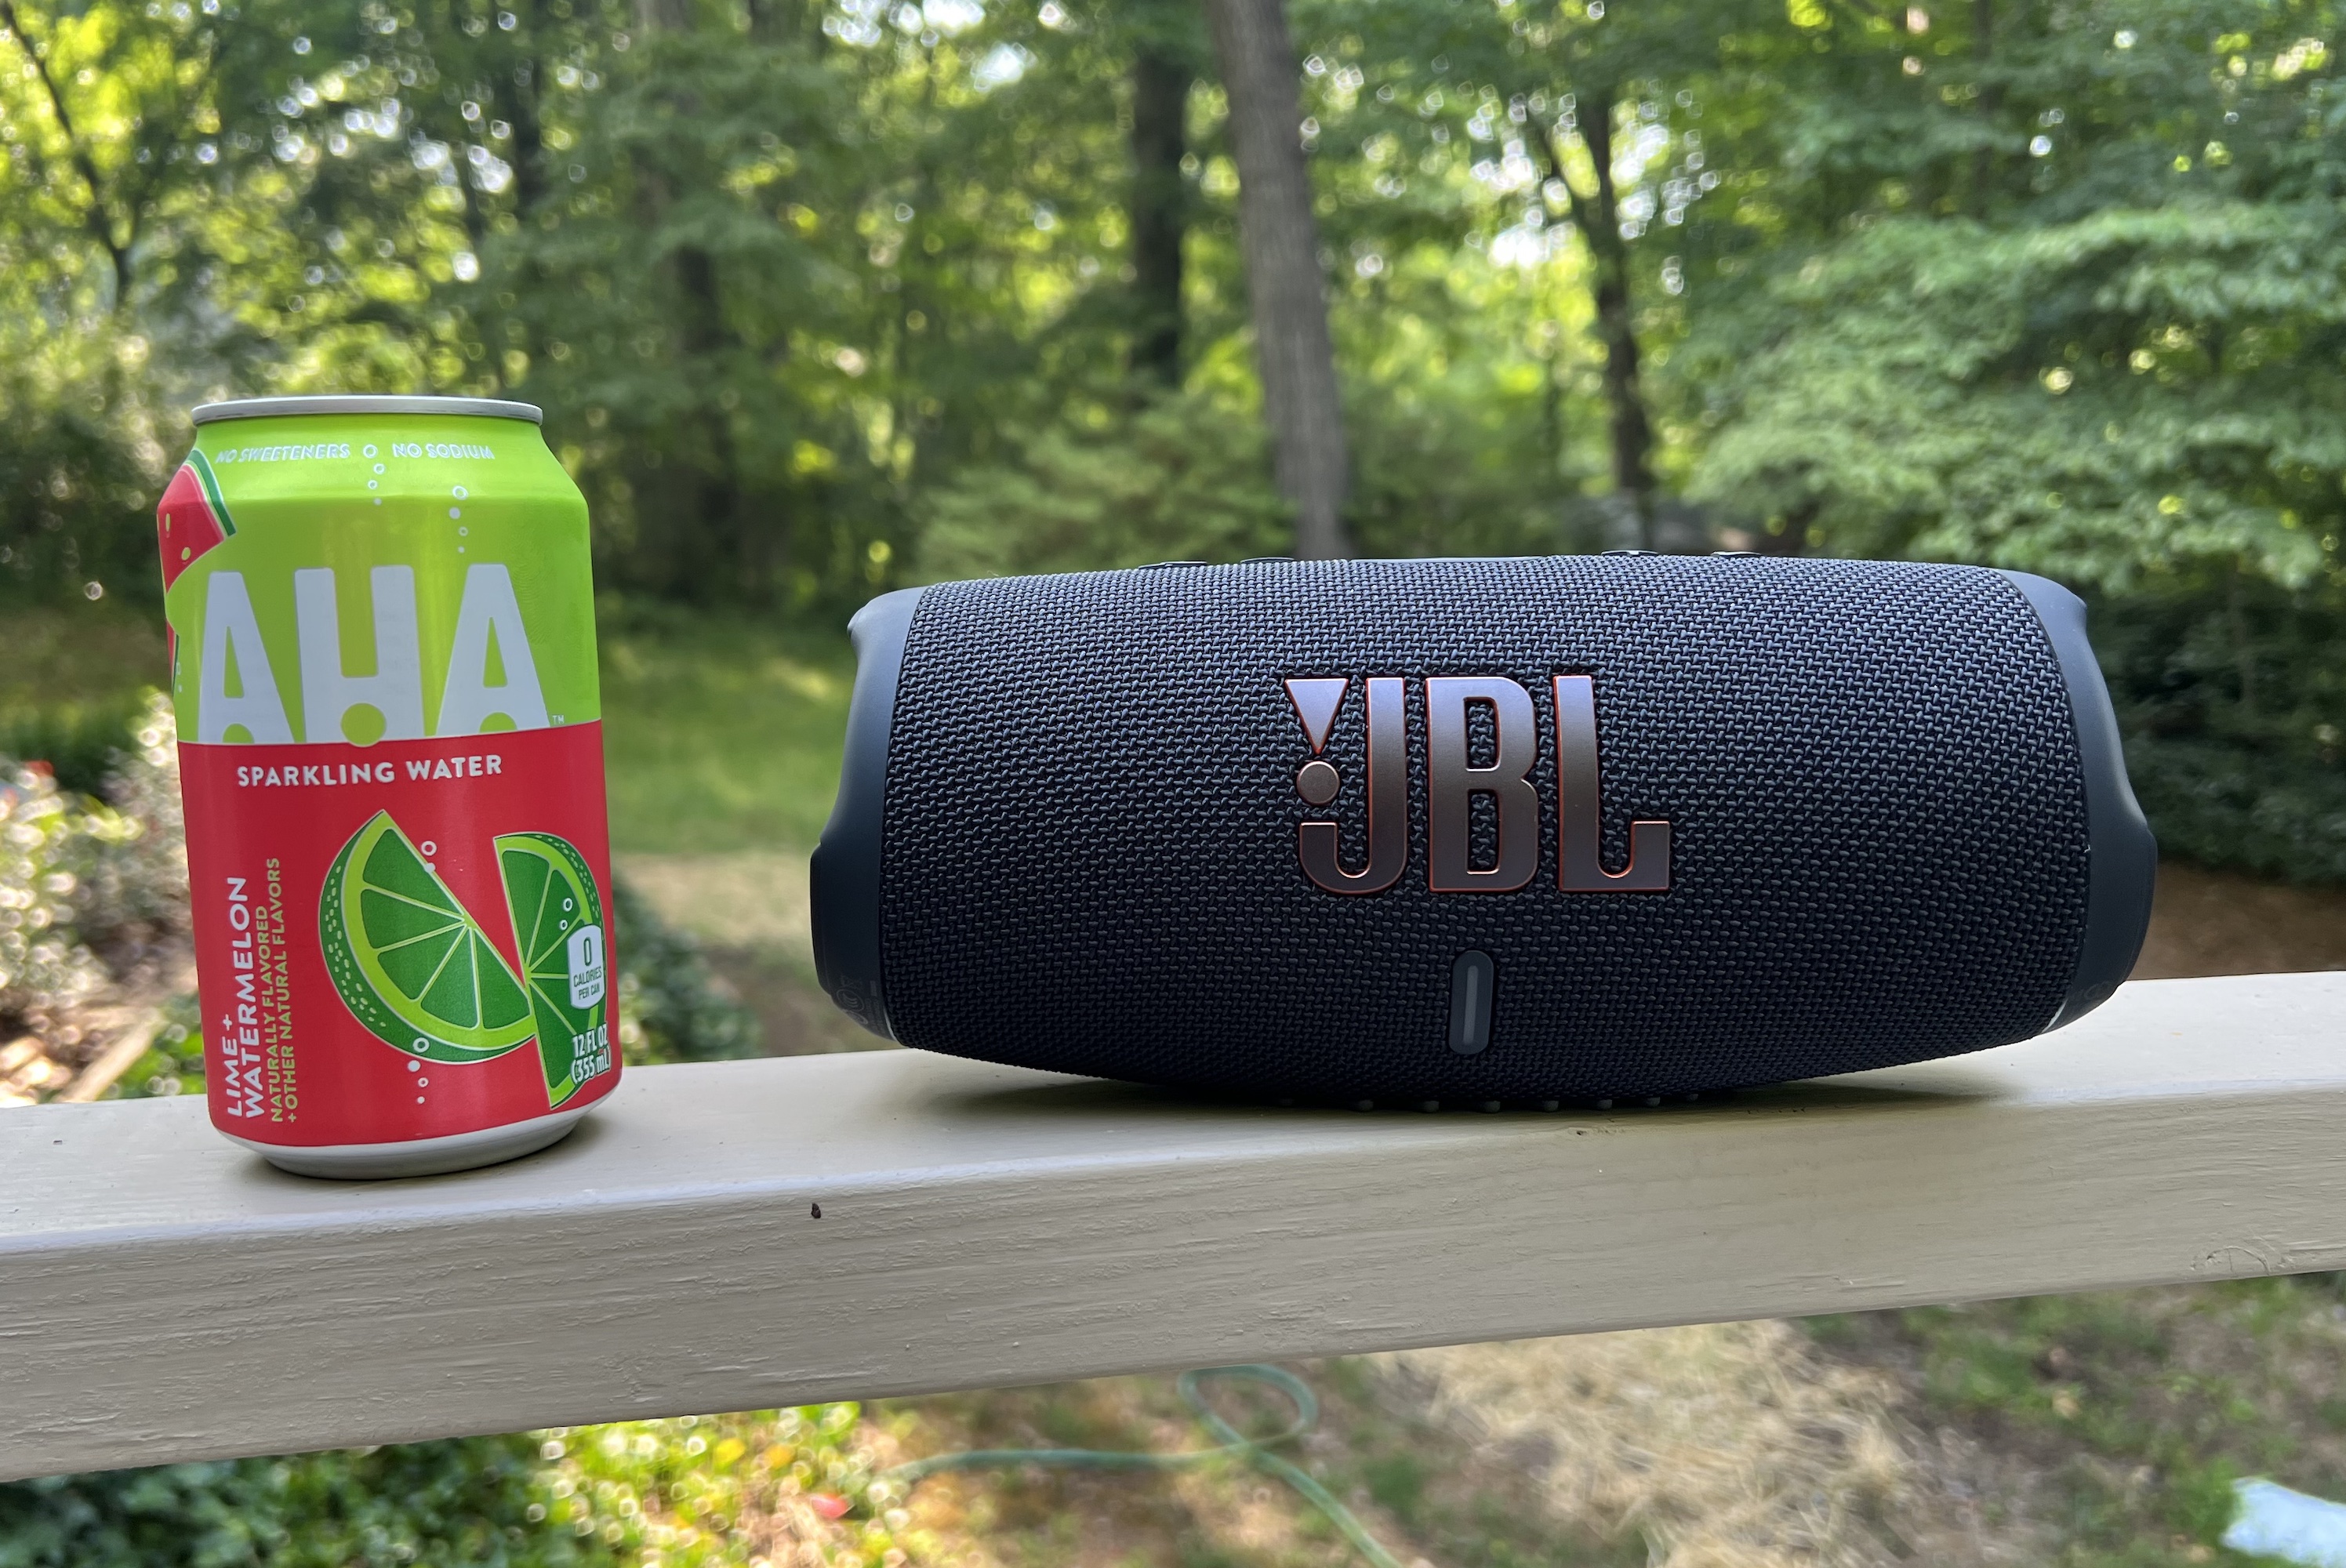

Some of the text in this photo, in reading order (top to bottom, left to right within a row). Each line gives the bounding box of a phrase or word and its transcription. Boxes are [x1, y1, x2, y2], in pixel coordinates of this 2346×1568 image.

[215, 443, 350, 464] NO SWEETENERS
[392, 443, 496, 460] NO SODIUM
[198, 563, 550, 745] AHA
[237, 754, 503, 786] SPARKLING WATER
[1299, 674, 1671, 895] JBL
[267, 858, 285, 945] FLAVORS
[573, 966, 602, 988] CALORIES
[583, 937, 592, 967] 0
[227, 877, 265, 1118] WATERMELON
[256, 906, 283, 1122] NATURALLY FLAVORED
[274, 951, 293, 1040] NATURAL
[578, 985, 600, 1000] PER CAN
[571, 1045, 611, 1083] (355 mL)
[572, 1024, 608, 1058] 12 FL OZ
[222, 1036, 243, 1116] LIME
[281, 1045, 298, 1109] OTHER
